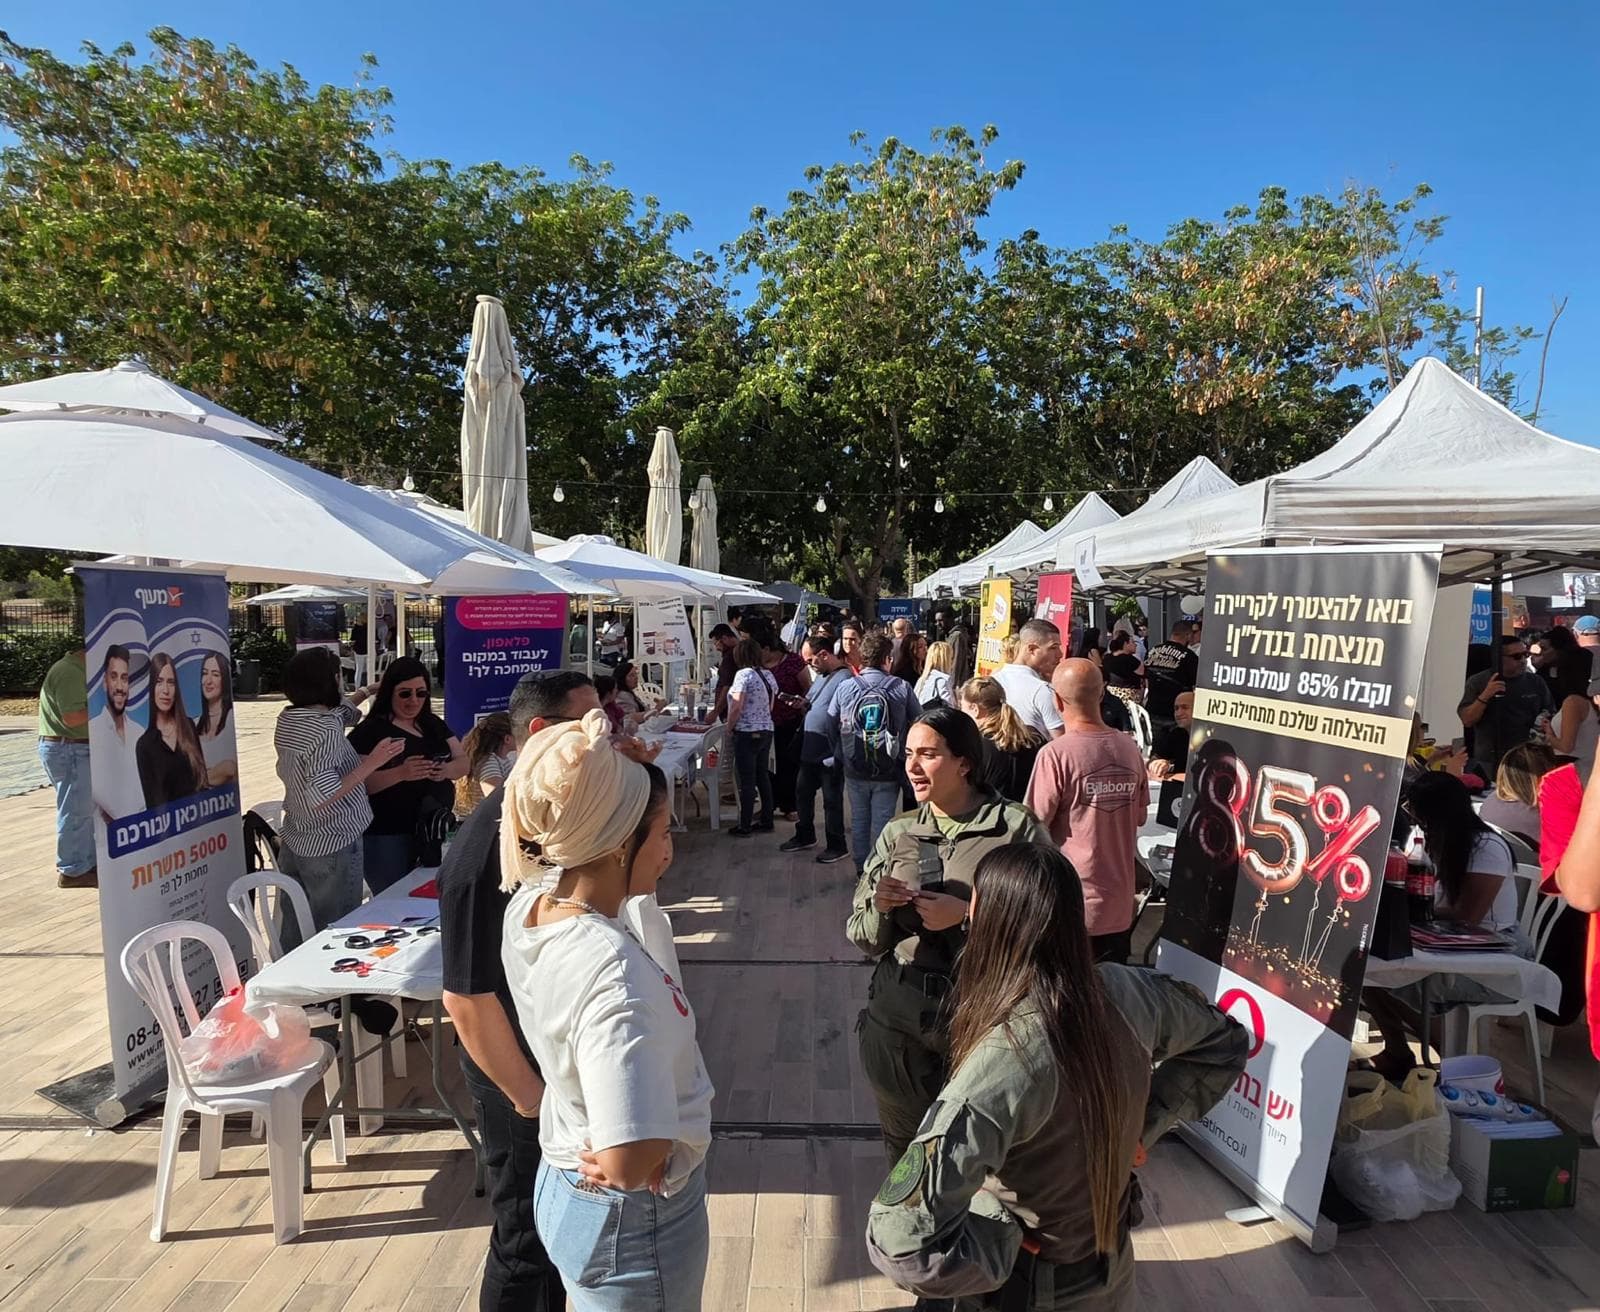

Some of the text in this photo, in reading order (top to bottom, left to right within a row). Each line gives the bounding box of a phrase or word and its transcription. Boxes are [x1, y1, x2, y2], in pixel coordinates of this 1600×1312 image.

[134, 587, 168, 609] משף
[1214, 592, 1414, 625] בואו להצטרף לקריירה
[462, 649, 549, 664] לעבוד במקום
[482, 636, 531, 650] פלאפון.
[1300, 632, 1385, 667] מנצחת
[468, 663, 542, 679] שמחכה לך!
[1212, 662, 1246, 687] סוכן!
[1248, 666, 1291, 692] עמלת
[1297, 671, 1338, 699] 85%
[1343, 676, 1392, 709] וקבלו
[1207, 698, 1388, 746] ההצלחה שלכם מתחילה כאן
[1085, 780, 1137, 795] Billabong
[116, 792, 236, 848] אנחנו כאן עבורכם
[1189, 753, 1381, 903] 85%
[131, 832, 228, 890] 5000 משרות
[159, 864, 209, 896] מחכות לך פה
[1233, 1071, 1295, 1120] יש בת
[1266, 1122, 1288, 1146] תיווך
